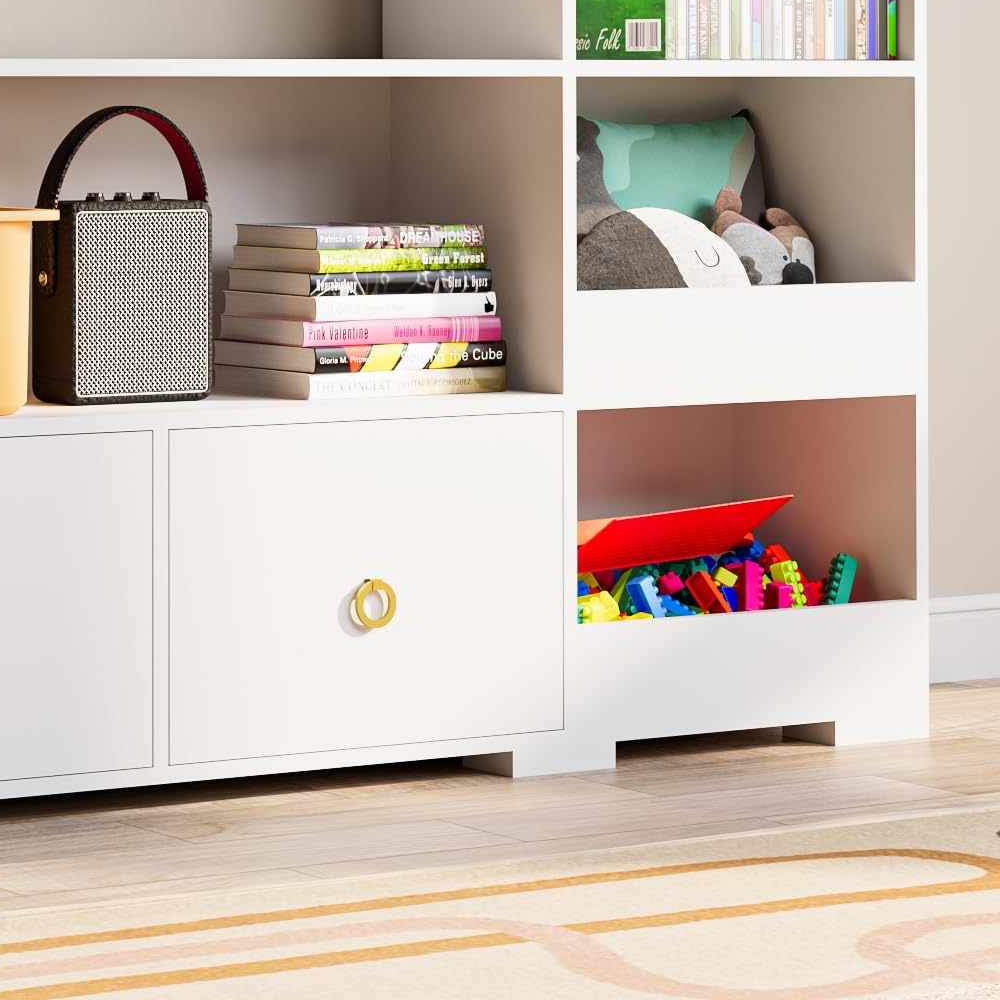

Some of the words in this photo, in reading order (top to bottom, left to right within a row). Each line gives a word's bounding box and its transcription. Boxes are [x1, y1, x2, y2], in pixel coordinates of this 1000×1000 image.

[595, 27, 622, 51] Folk
[319, 234, 346, 243] Patricia
[357, 234, 389, 244] Seppard
[421, 252, 450, 265] Green
[453, 251, 485, 264] Forest
[316, 278, 358, 293] Neurobiology
[448, 275, 462, 288] Glen
[471, 275, 488, 289] Byers
[308, 325, 326, 342] Pink
[327, 325, 369, 341] Valentine
[393, 325, 418, 338] Weldon
[320, 356, 339, 365] Gloria
[340, 356, 348, 364] M.
[350, 356, 375, 364] Pittm
[450, 350, 469, 361] the
[472, 347, 503, 361] Cube
